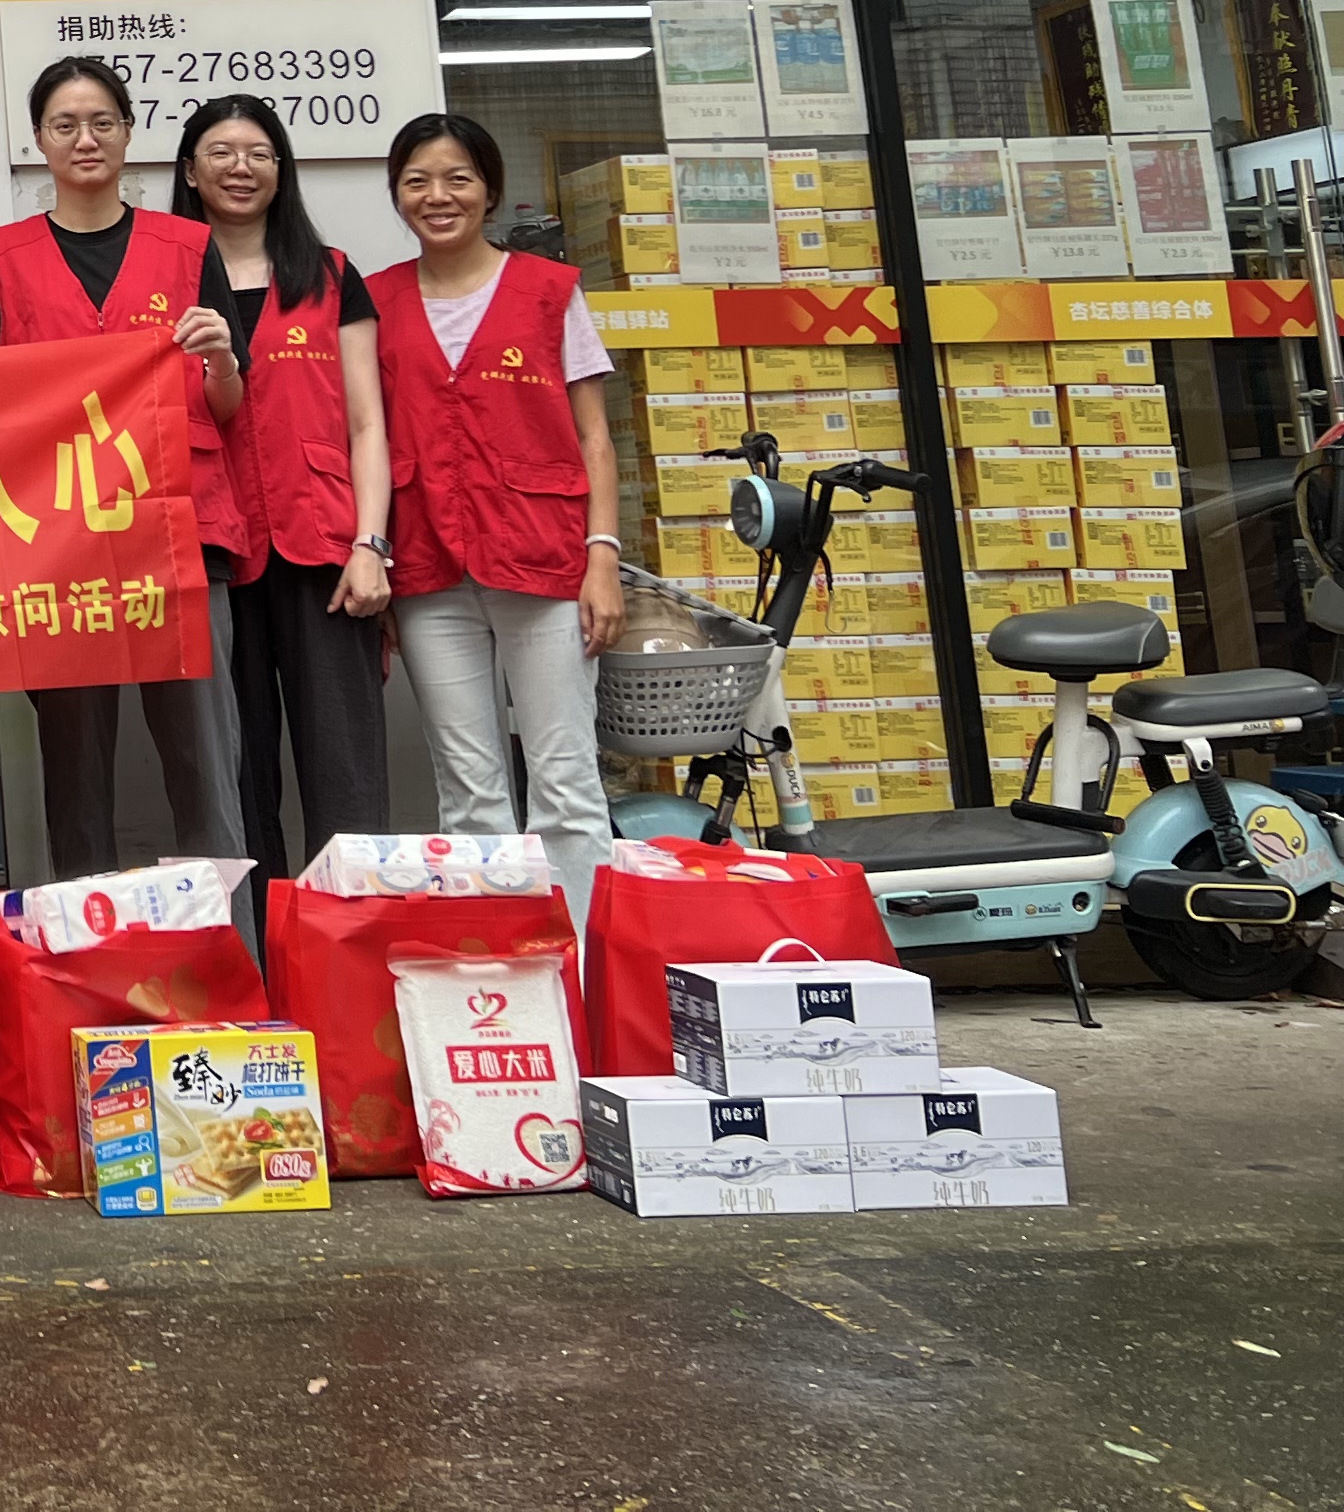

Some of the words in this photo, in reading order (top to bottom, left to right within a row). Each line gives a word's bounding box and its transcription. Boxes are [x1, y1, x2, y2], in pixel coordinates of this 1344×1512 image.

[62, 49, 375, 84] 57-27683399
[1068, 299, 1214, 321] 杏坛慈善综合体
[786, 769, 801, 799] DUCK
[248, 1042, 297, 1059] 万士发
[242, 1060, 306, 1084] 梳打饼干
[452, 1049, 549, 1080] 爱心大米
[806, 1067, 864, 1093] 纯牛奶
[718, 1186, 777, 1212] 纯牛奶
[933, 1180, 991, 1206] 纯牛奶
